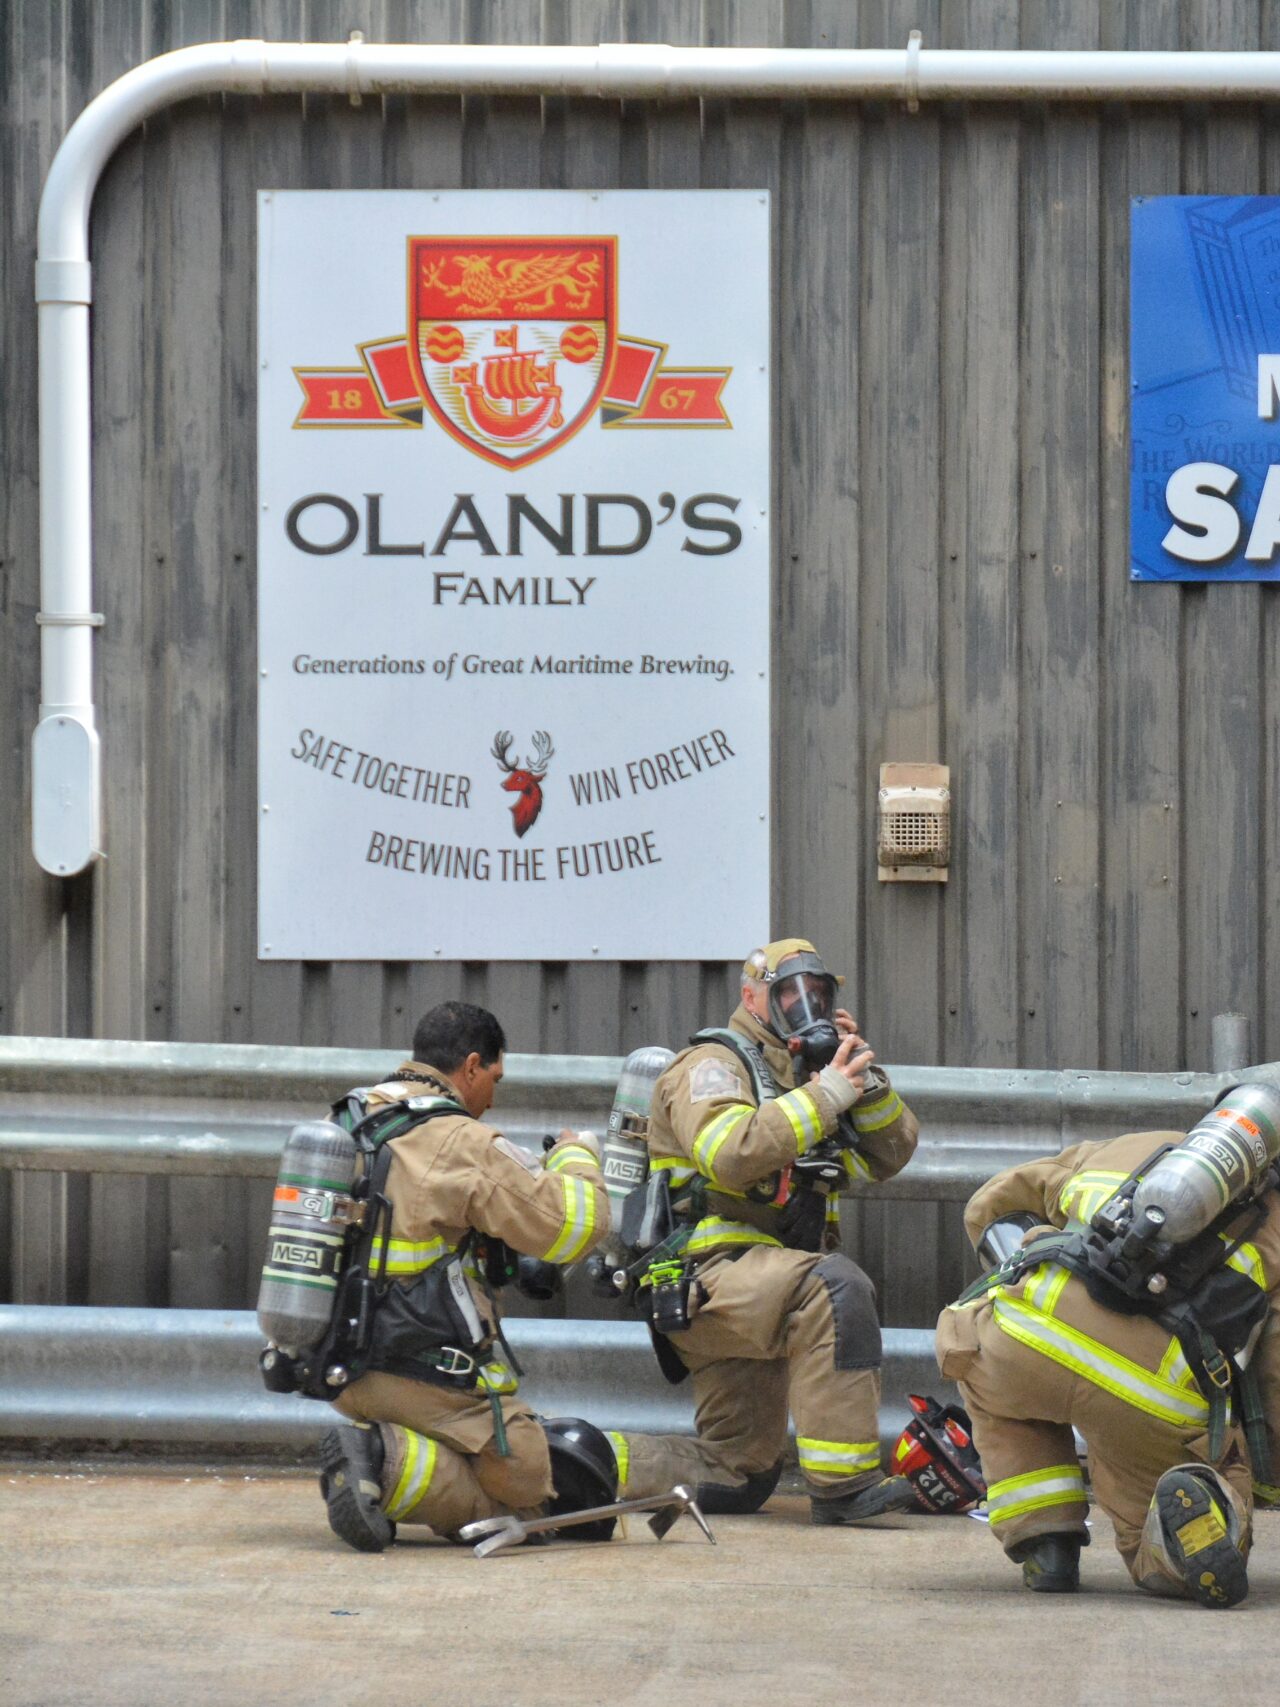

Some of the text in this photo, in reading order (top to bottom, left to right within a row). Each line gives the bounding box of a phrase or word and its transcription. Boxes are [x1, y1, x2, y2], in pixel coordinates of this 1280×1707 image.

[327, 388, 363, 410] 18
[659, 387, 696, 411] 67
[285, 491, 743, 558] OLAND'S
[432, 571, 597, 606] FAMILY
[292, 653, 736, 682] Generations of Great Maritime Brewing.
[290, 728, 471, 809] SAFE TOGETHER
[569, 729, 736, 807] WIN FOREVER
[365, 830, 662, 882] BREWING THE FUTURE
[605, 1160, 645, 1182] MSA
[1192, 1137, 1237, 1173] MSA
[274, 1244, 320, 1266] MSA
